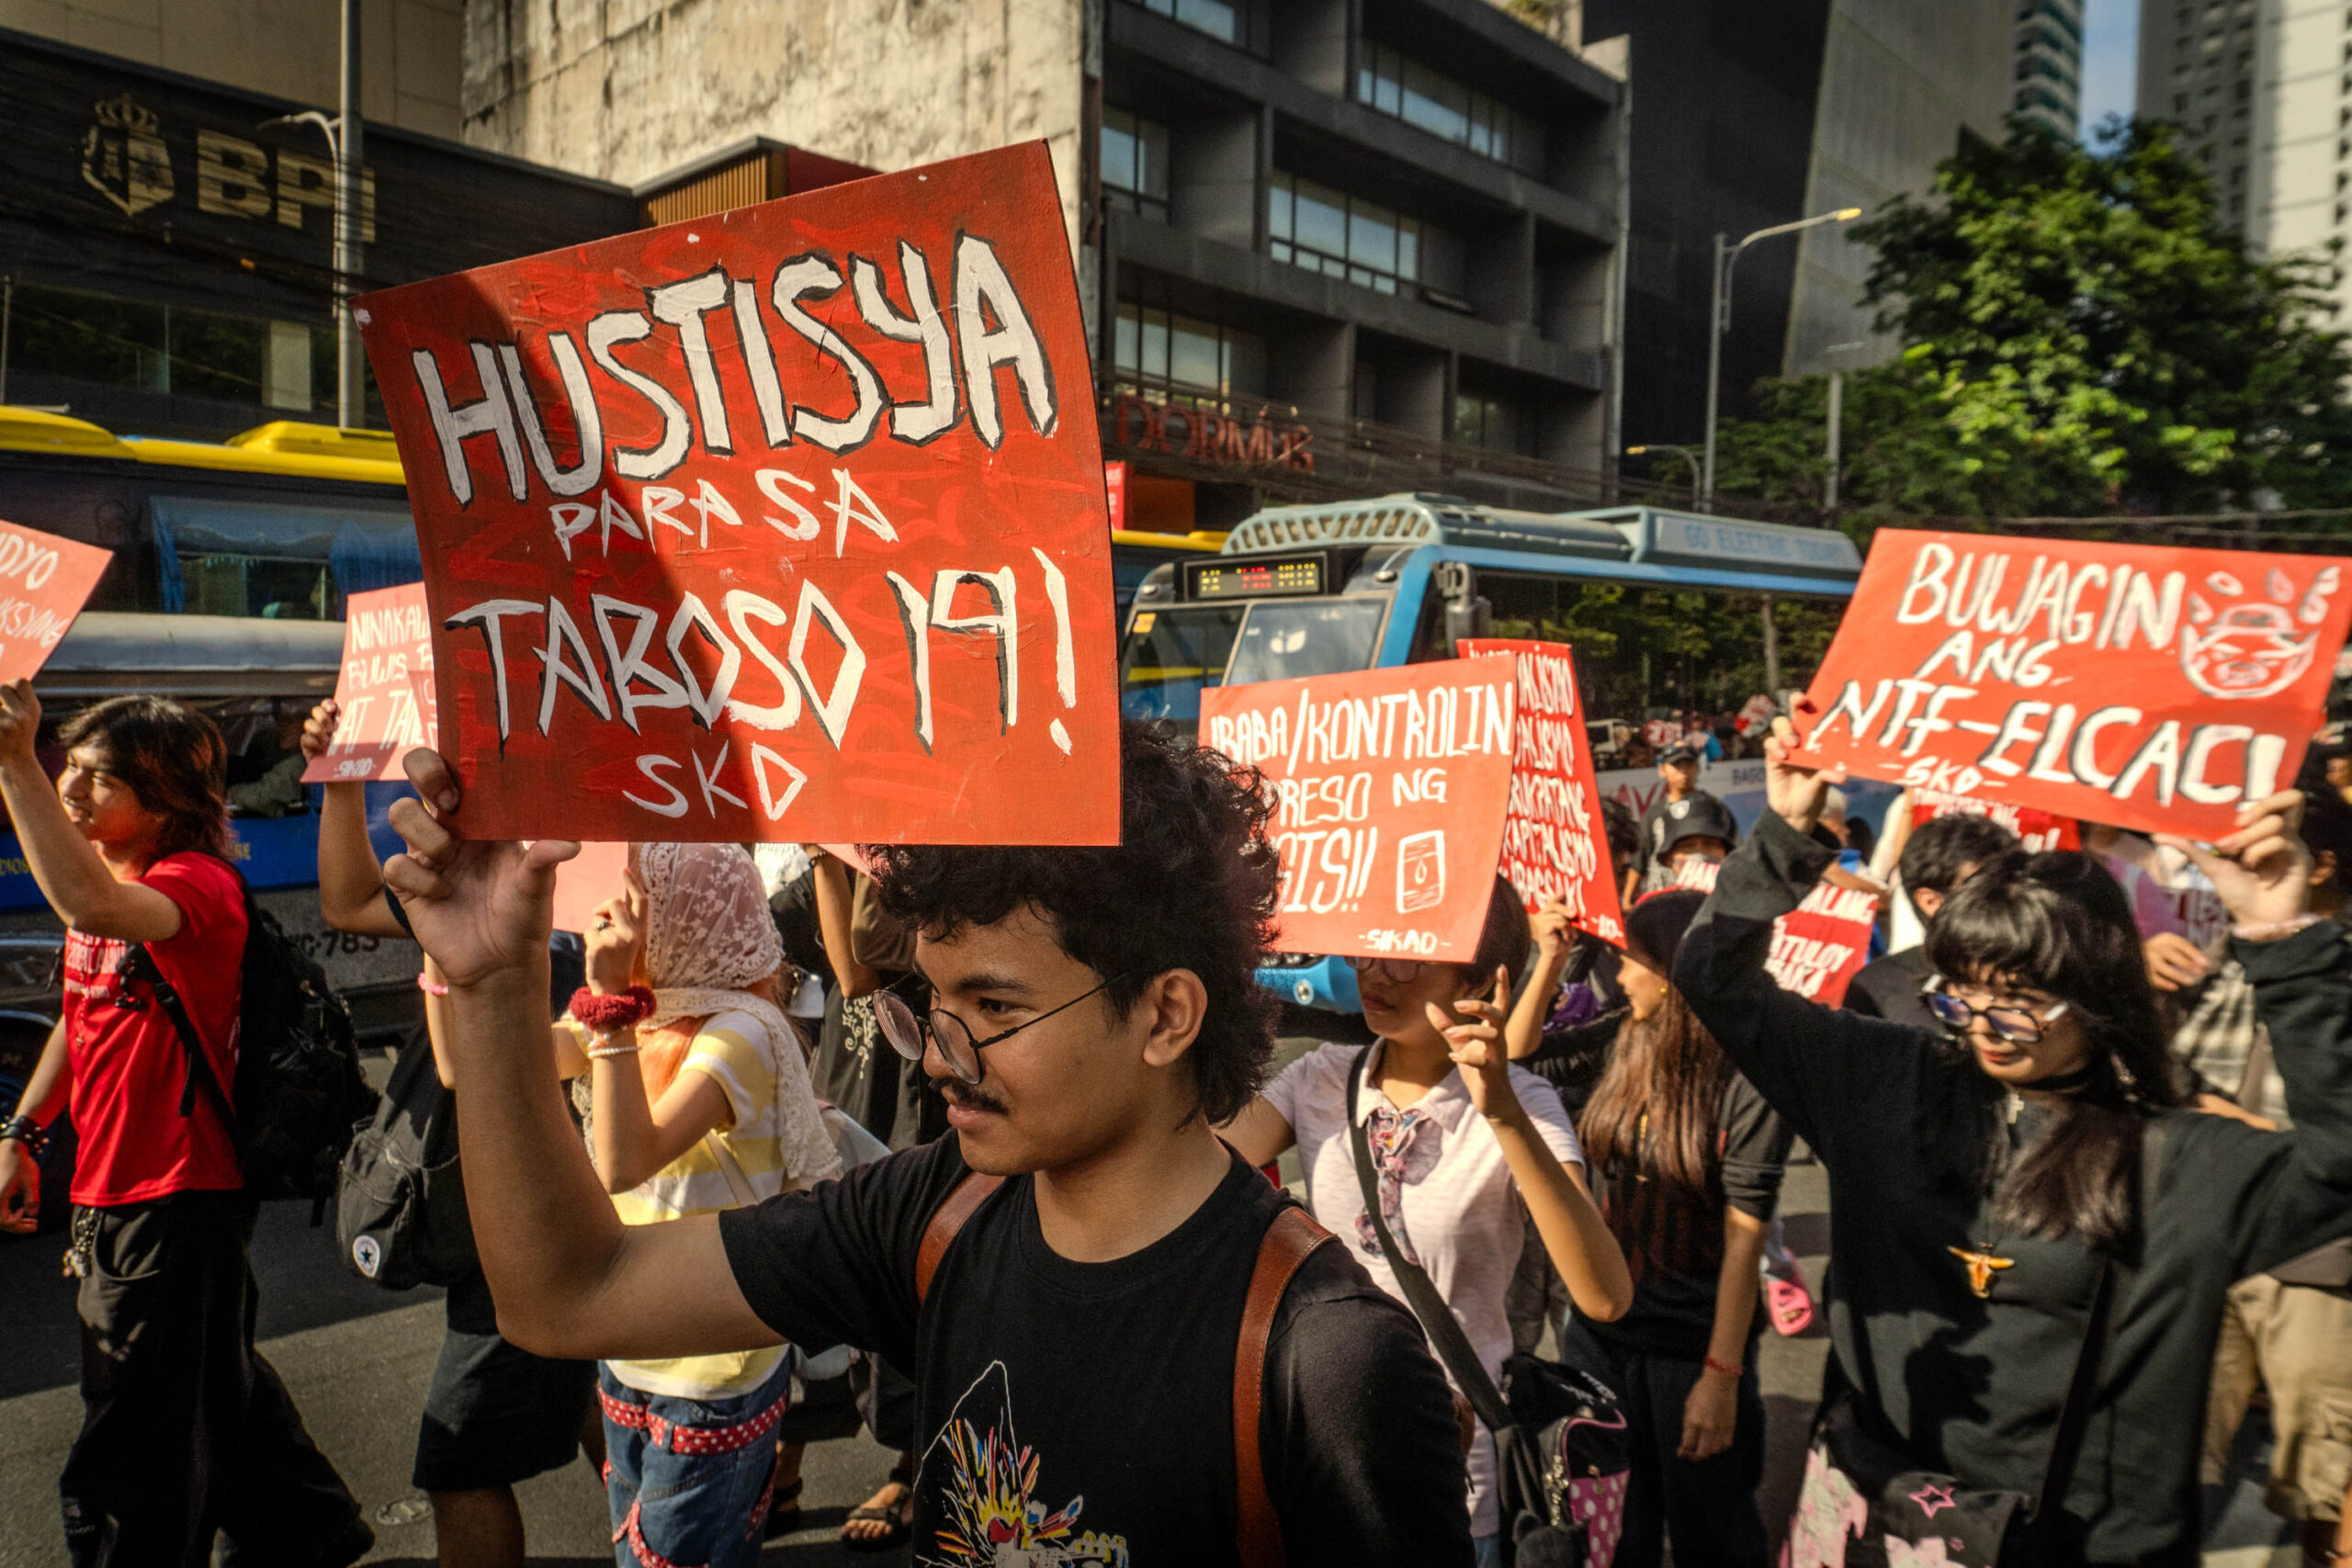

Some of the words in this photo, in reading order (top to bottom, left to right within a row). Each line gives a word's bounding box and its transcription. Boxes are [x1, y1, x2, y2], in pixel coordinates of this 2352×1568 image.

[411, 228, 1059, 508] HUSTISYA
[0, 531, 59, 591] DYO
[548, 477, 743, 562] PARA
[754, 468, 901, 560] SA
[1895, 542, 2186, 651] BUWAGIN
[444, 577, 867, 761] TABOSO
[621, 740, 808, 821] SKD
[1393, 768, 1447, 807] NG
[1804, 679, 2287, 812] NTF-ELCAC!
